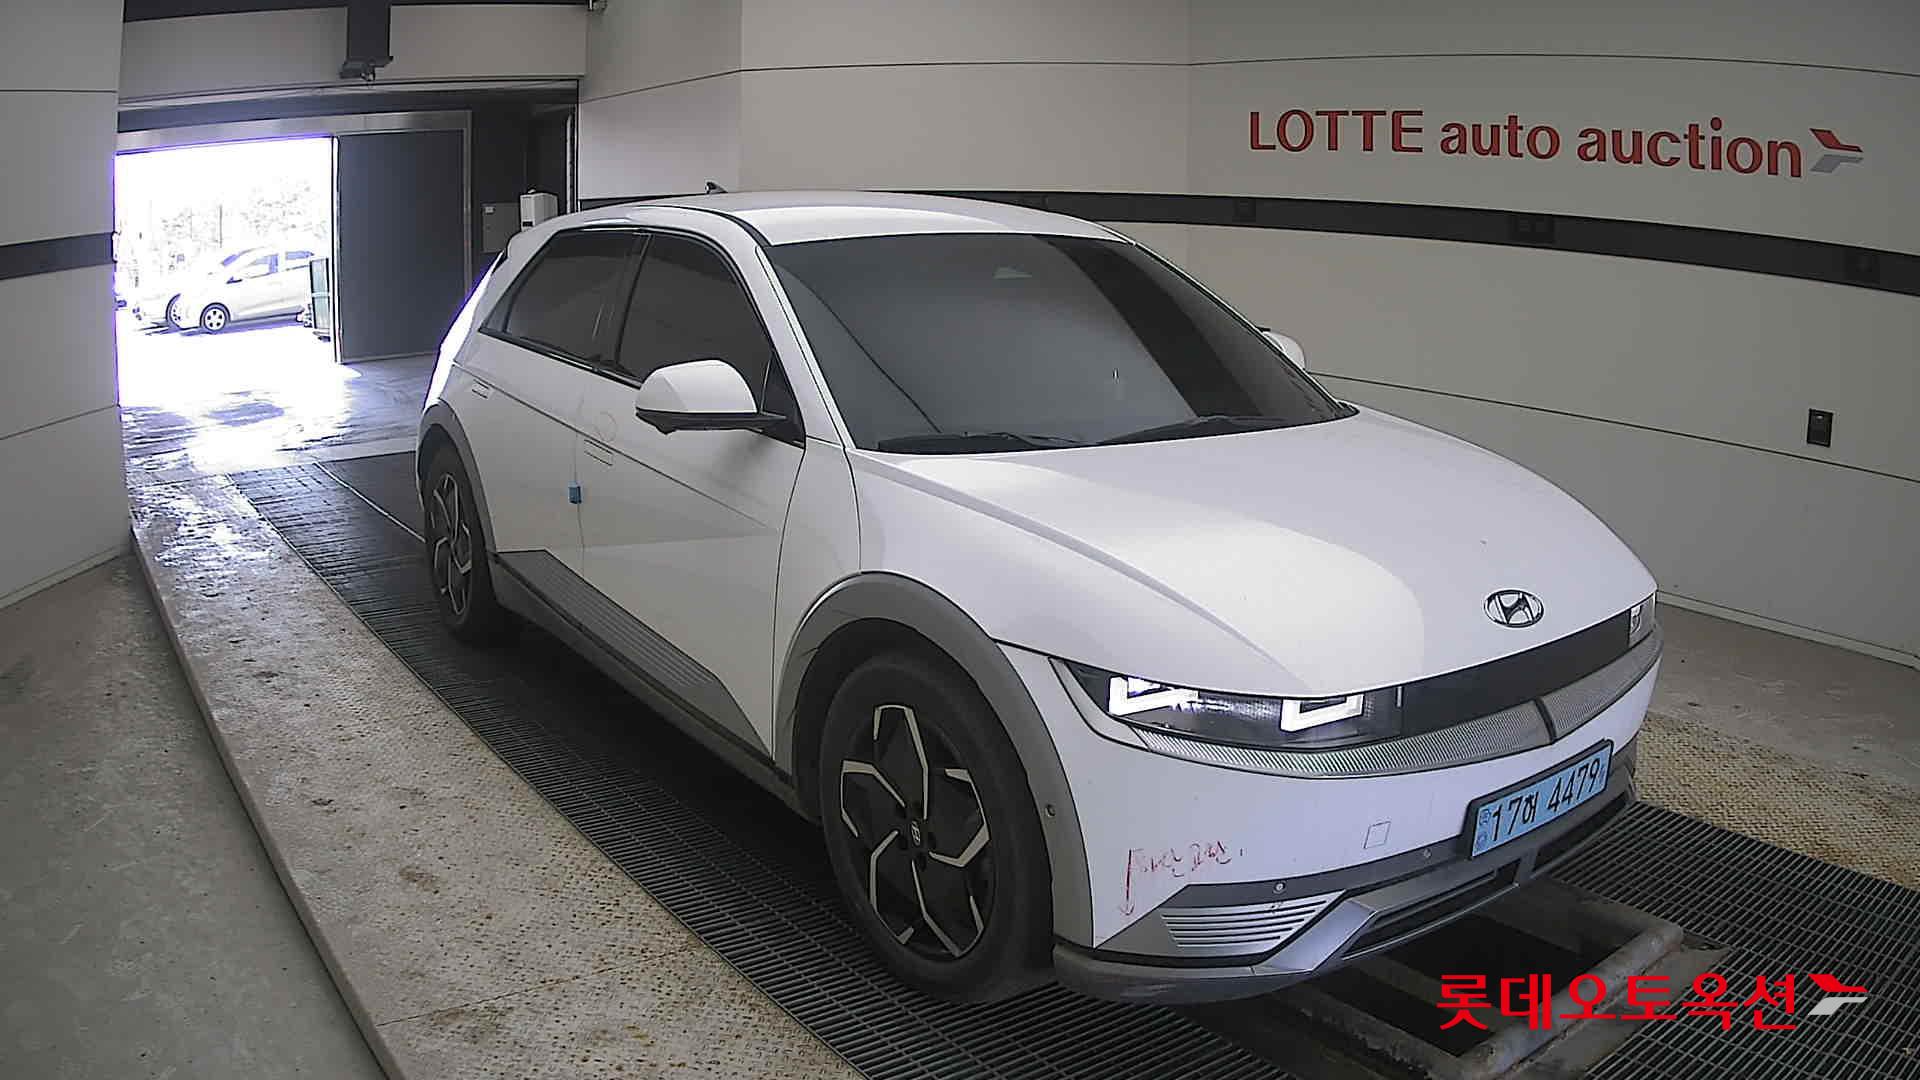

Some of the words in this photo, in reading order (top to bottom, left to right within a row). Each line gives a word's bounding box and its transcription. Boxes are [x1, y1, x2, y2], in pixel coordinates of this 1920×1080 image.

[1249, 109, 1424, 153] LOTTE
[1440, 114, 1560, 160] auto
[1577, 119, 1802, 176] auction
[1492, 791, 1539, 842] 17허
[1548, 758, 1600, 812] 4479
